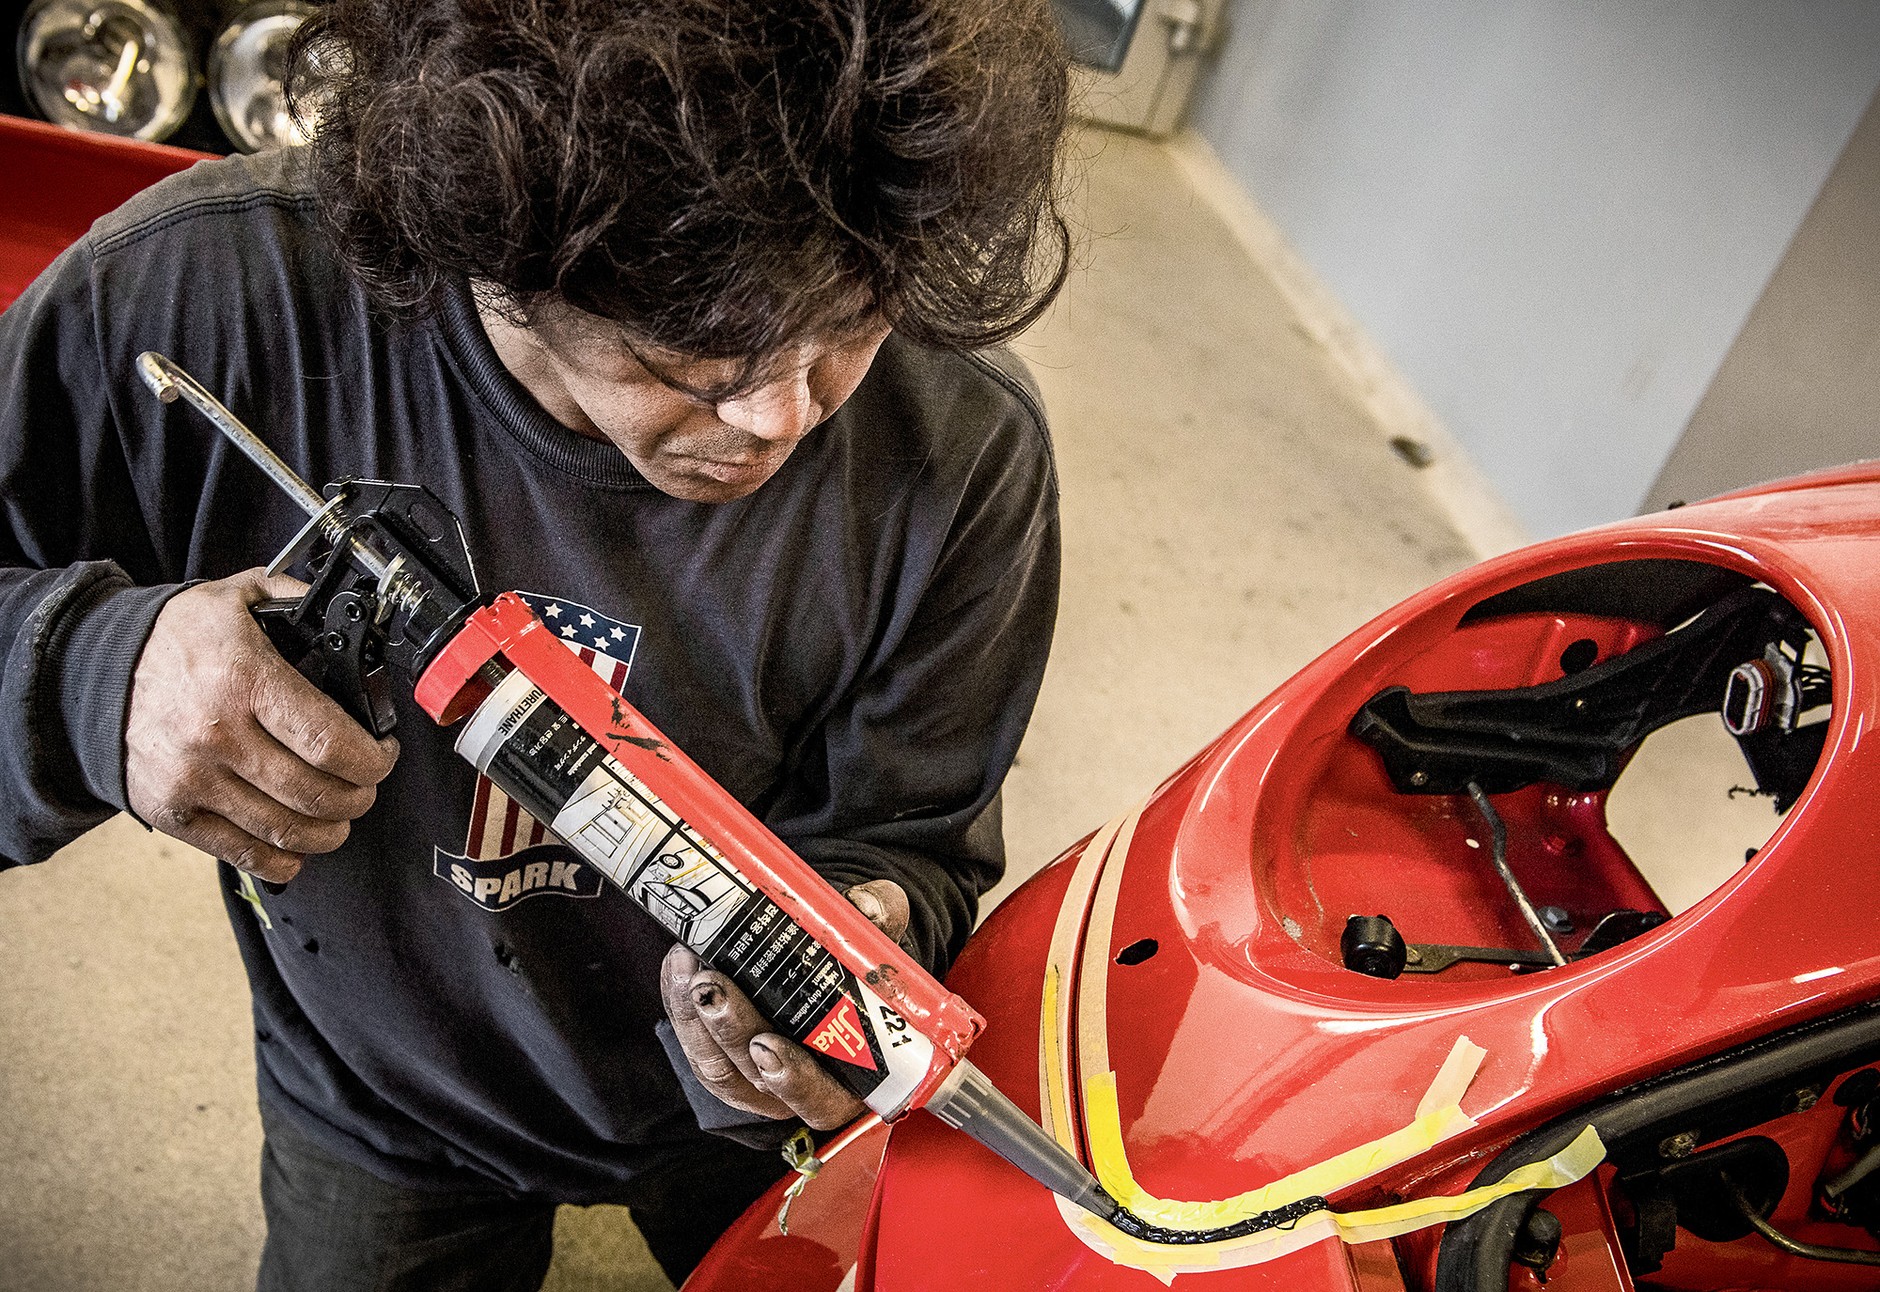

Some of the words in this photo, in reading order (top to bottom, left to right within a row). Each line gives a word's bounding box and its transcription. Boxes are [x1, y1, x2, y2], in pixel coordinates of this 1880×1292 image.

[450, 861, 581, 903] SPARK
[728, 932, 754, 960] 실란트
[749, 921, 801, 978] 途粘接密封胶
[811, 961, 834, 986] sealant
[819, 970, 839, 991] Heavy
[807, 988, 822, 1004] duty
[812, 1005, 865, 1058] Sika
